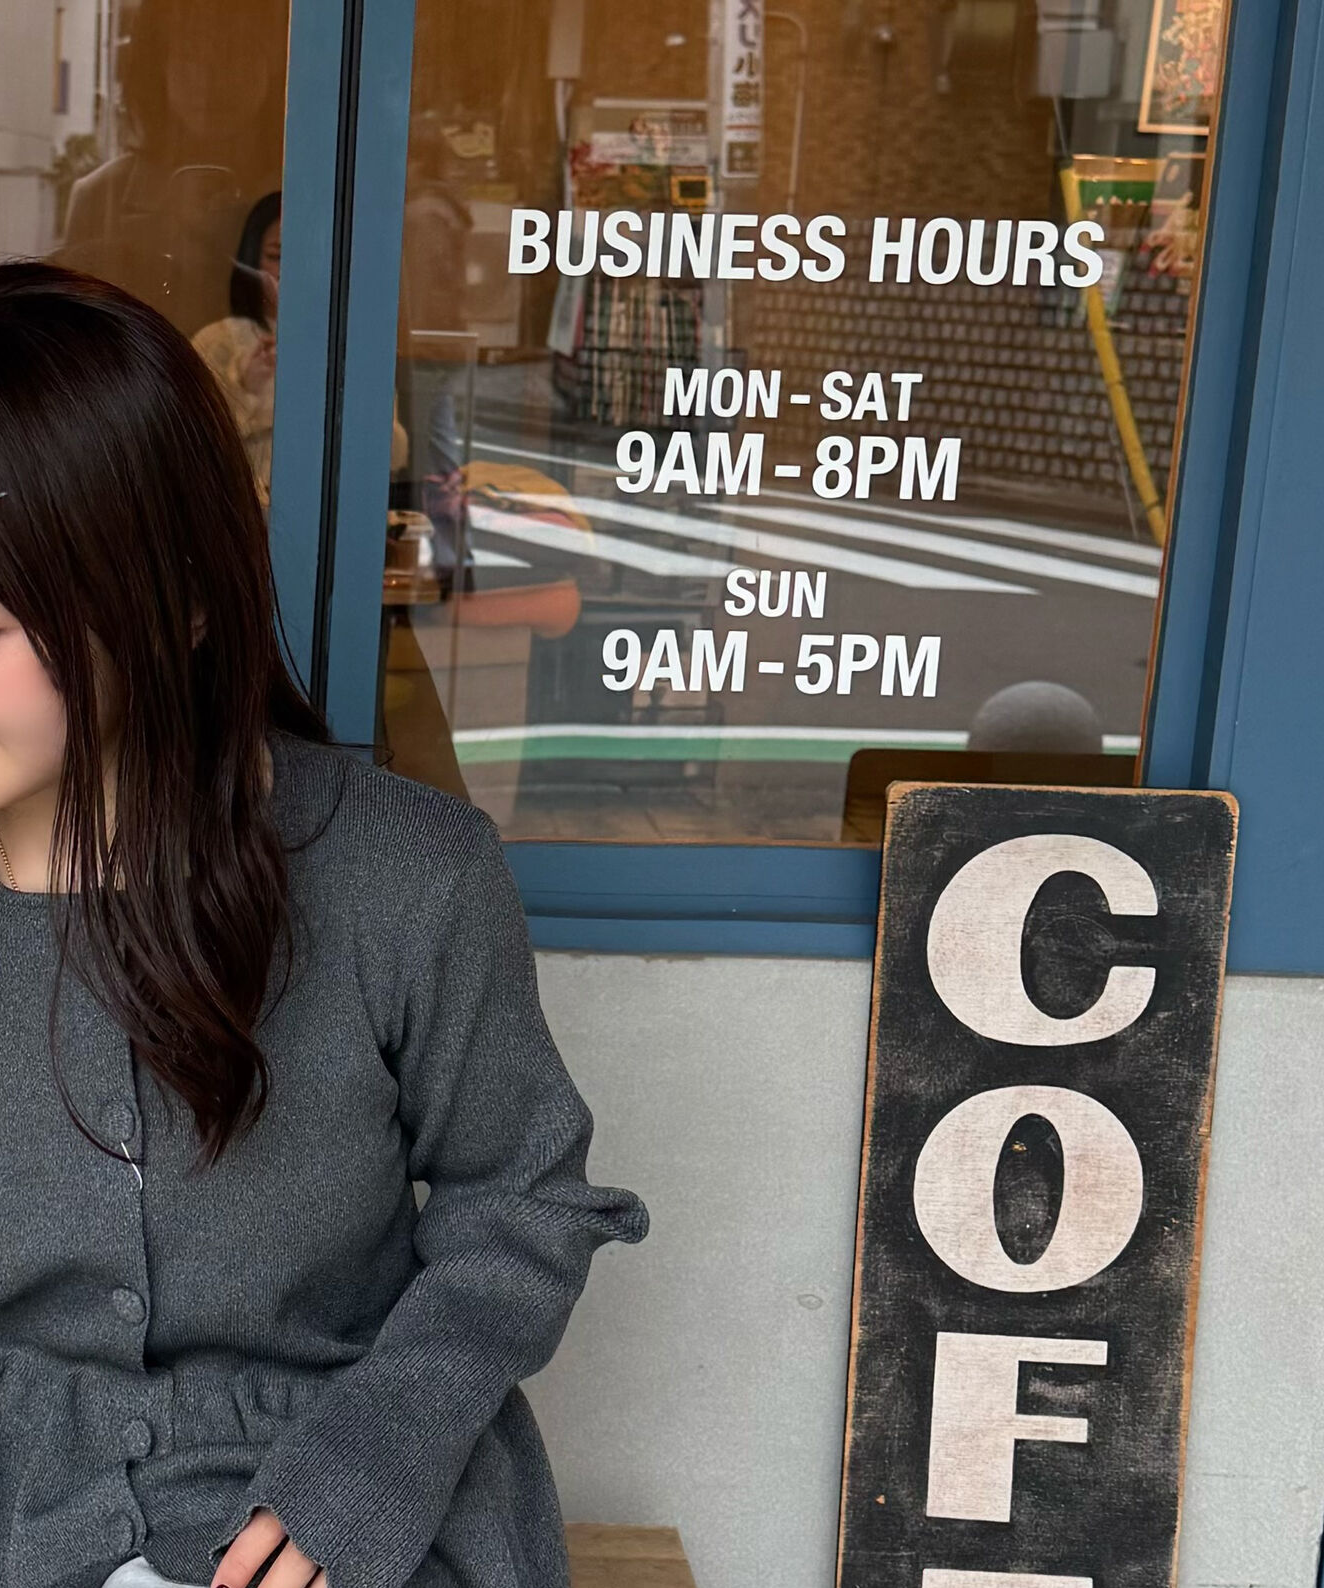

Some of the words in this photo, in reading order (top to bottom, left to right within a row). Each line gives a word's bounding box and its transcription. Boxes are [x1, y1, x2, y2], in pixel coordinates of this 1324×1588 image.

[508, 209, 846, 282] BUSINESS
[869, 217, 1105, 288] HOURS
[724, 568, 827, 619] SUN
